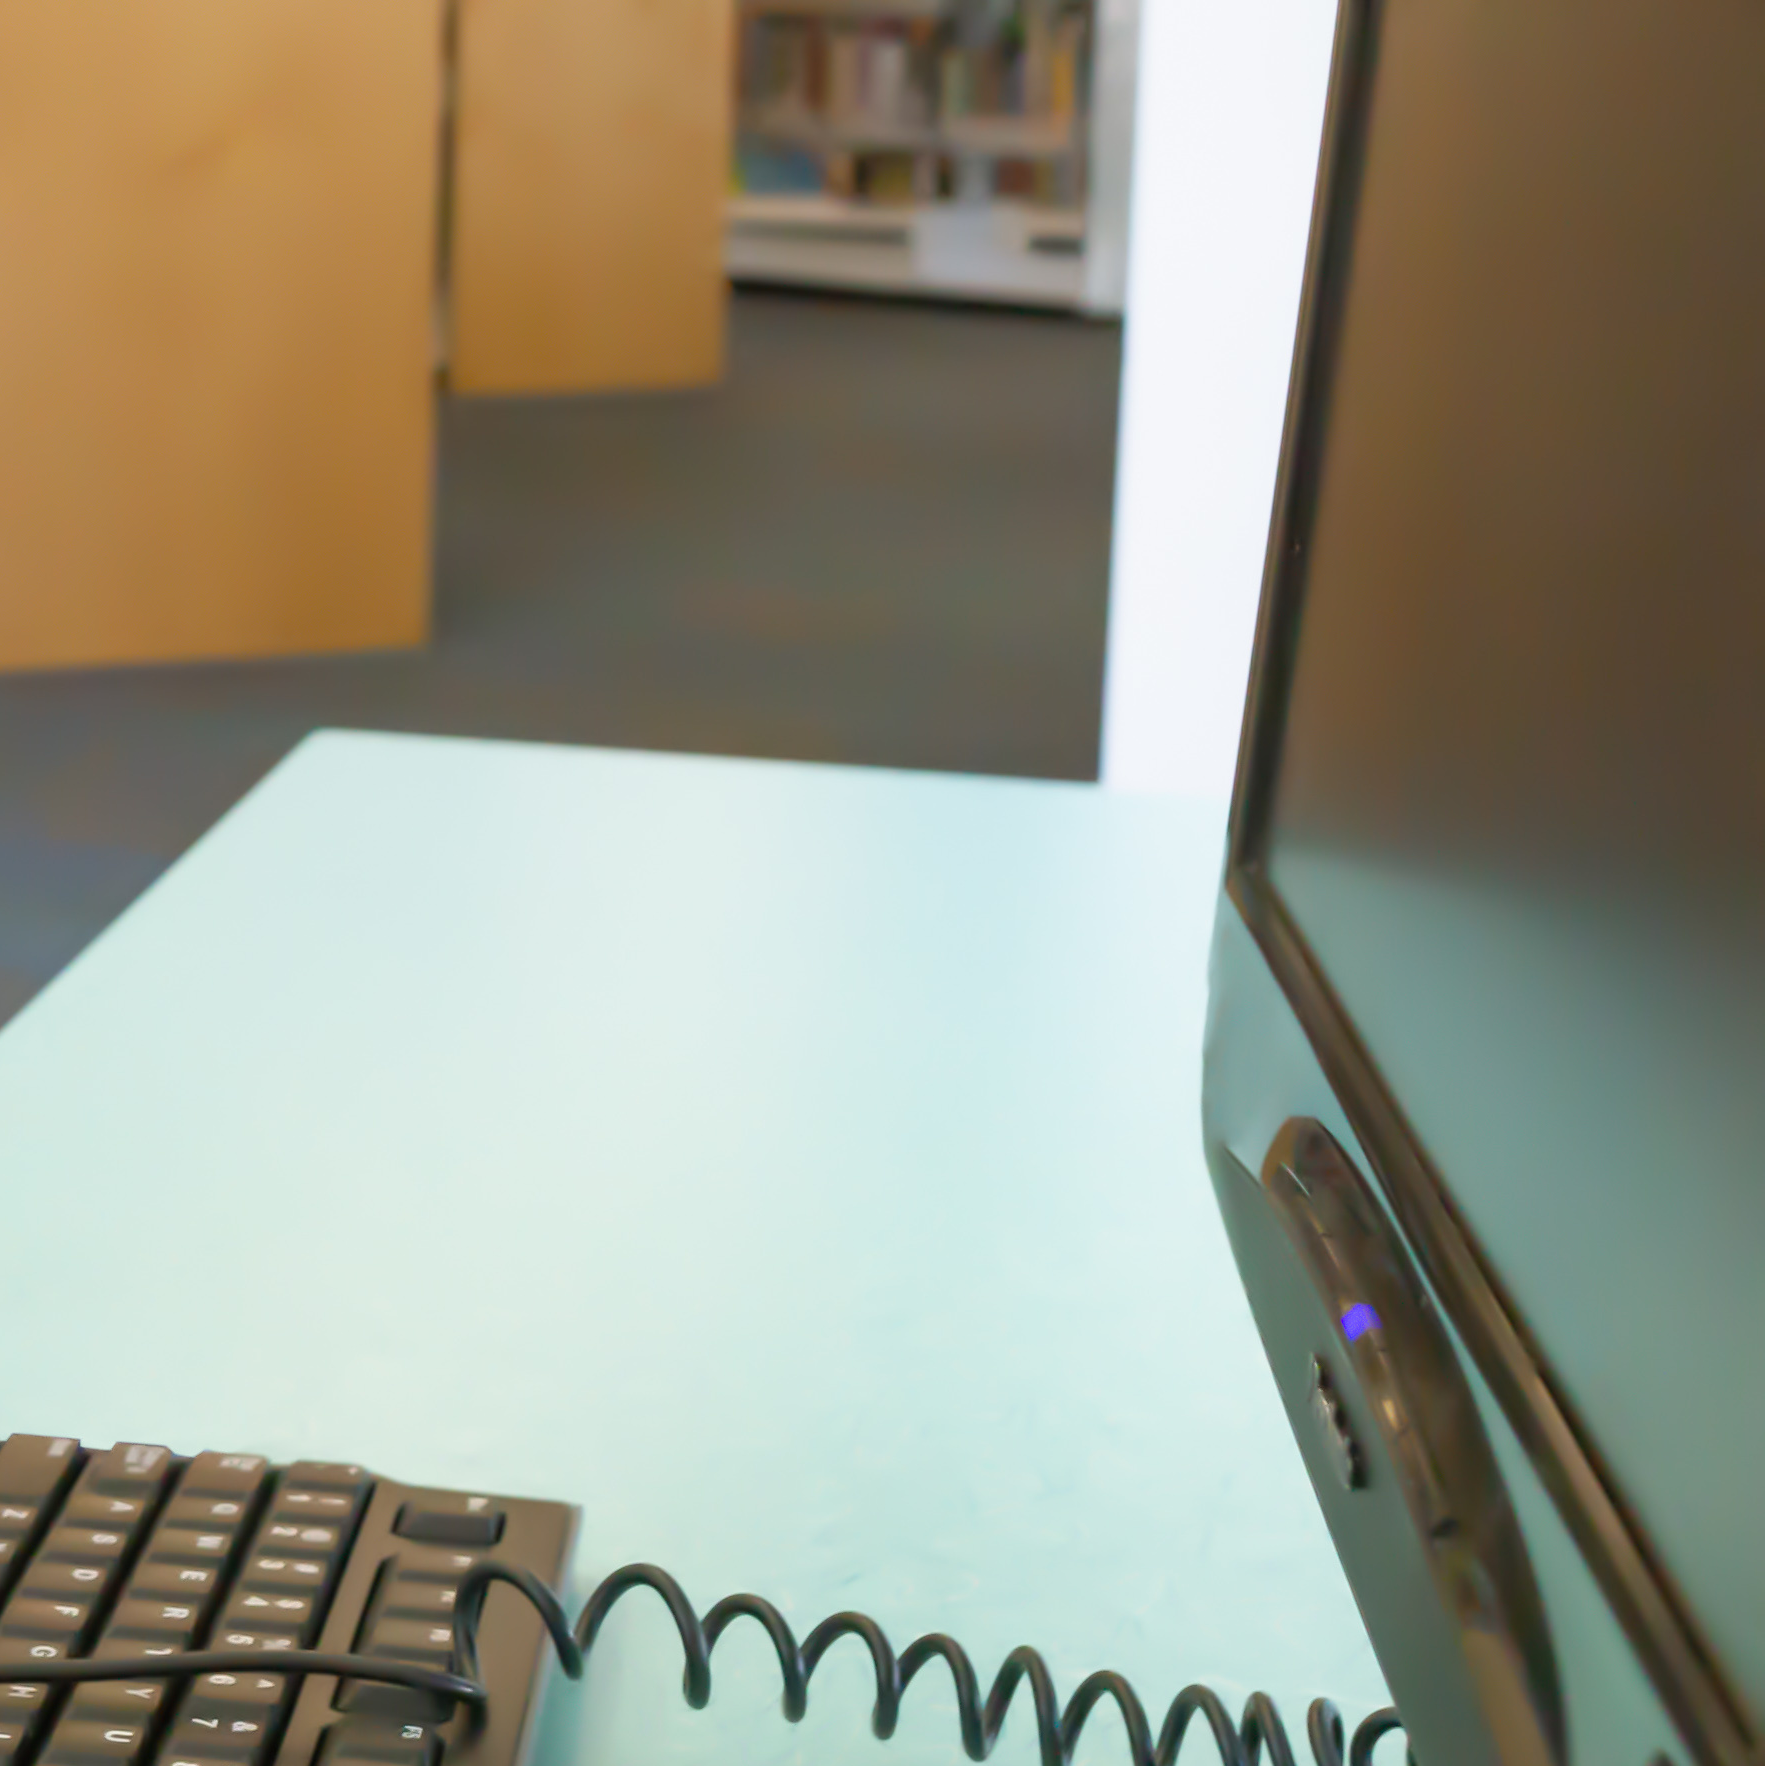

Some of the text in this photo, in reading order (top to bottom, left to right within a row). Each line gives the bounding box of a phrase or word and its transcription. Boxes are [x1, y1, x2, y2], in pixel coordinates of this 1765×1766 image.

[0, 1507, 30, 1521] Z
[70, 1567, 101, 1582] D
[177, 1568, 210, 1583] E
[52, 1604, 81, 1618] F
[160, 1605, 191, 1620] R
[28, 1644, 60, 1659] G
[7, 1684, 38, 1699] H
[124, 1686, 155, 1700] Y
[191, 1717, 219, 1729] 7
[102, 1728, 136, 1744] U
